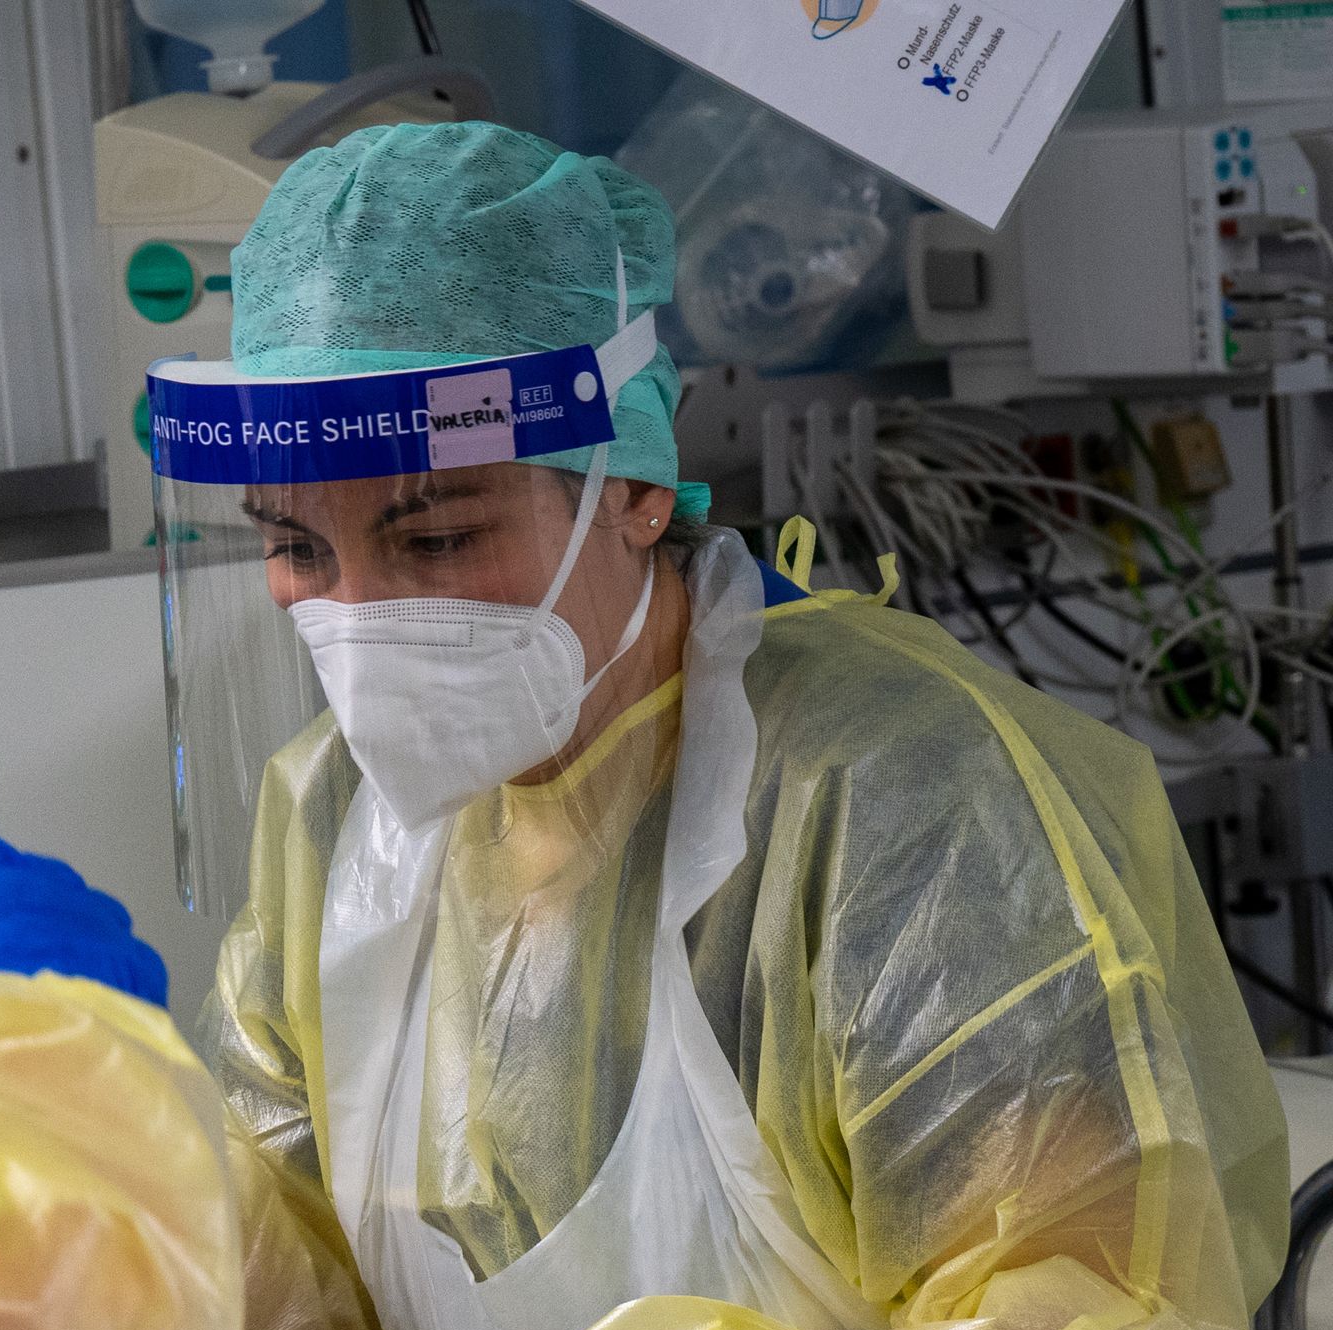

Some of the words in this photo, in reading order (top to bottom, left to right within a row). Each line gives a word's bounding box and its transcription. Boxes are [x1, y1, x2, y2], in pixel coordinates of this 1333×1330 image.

[905, 25, 929, 56] Mund-
[919, 3, 962, 65] Nasenschutz
[942, 14, 983, 76] FFP2-Maske
[964, 26, 1006, 89] FFP3-Maske
[521, 386, 552, 404] REF
[153, 411, 233, 447] ANTI-FOG
[242, 413, 312, 446] FACE
[321, 407, 431, 442] SHIELD
[430, 406, 506, 434] VALERIA
